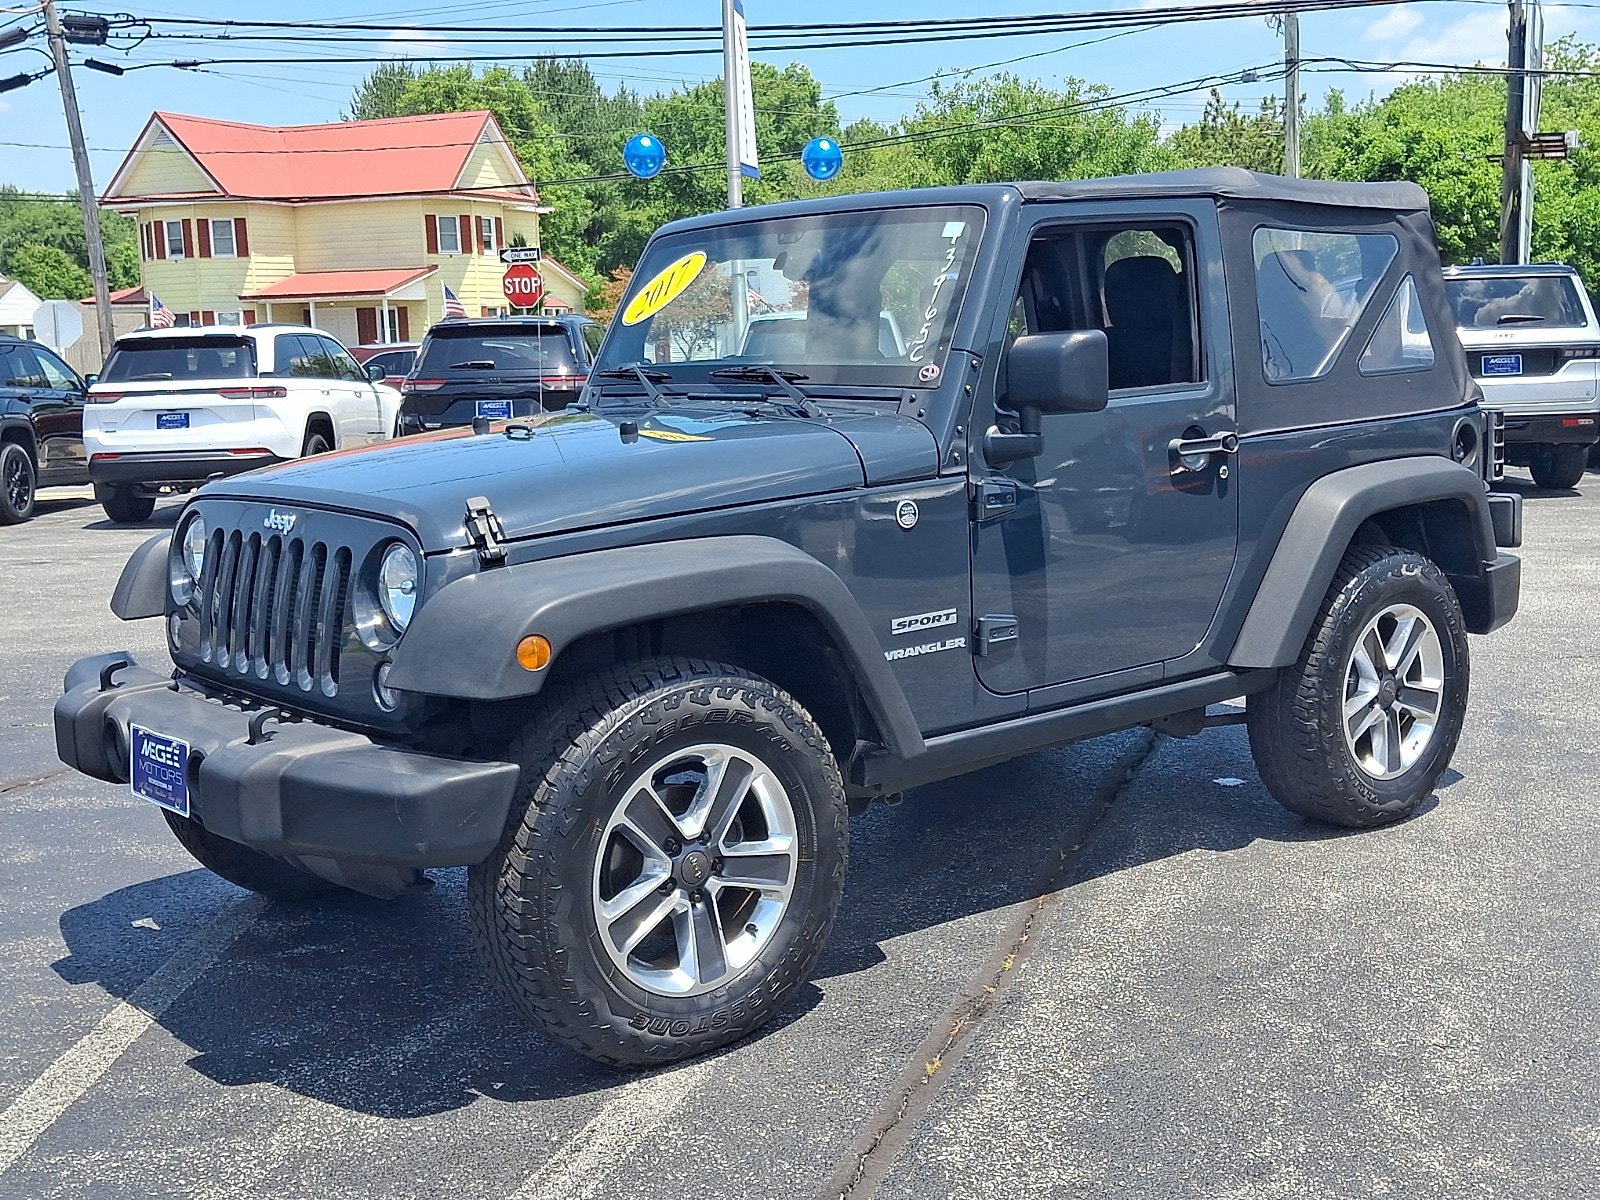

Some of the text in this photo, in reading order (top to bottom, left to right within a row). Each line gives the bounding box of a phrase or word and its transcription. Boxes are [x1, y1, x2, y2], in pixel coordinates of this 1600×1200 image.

[504, 277, 541, 294] STOP
[633, 259, 692, 320] 2017
[908, 237, 957, 362] 3965C
[263, 508, 297, 536] Jeep
[893, 611, 957, 631] SPORT
[138, 759, 183, 786] MOTORS
